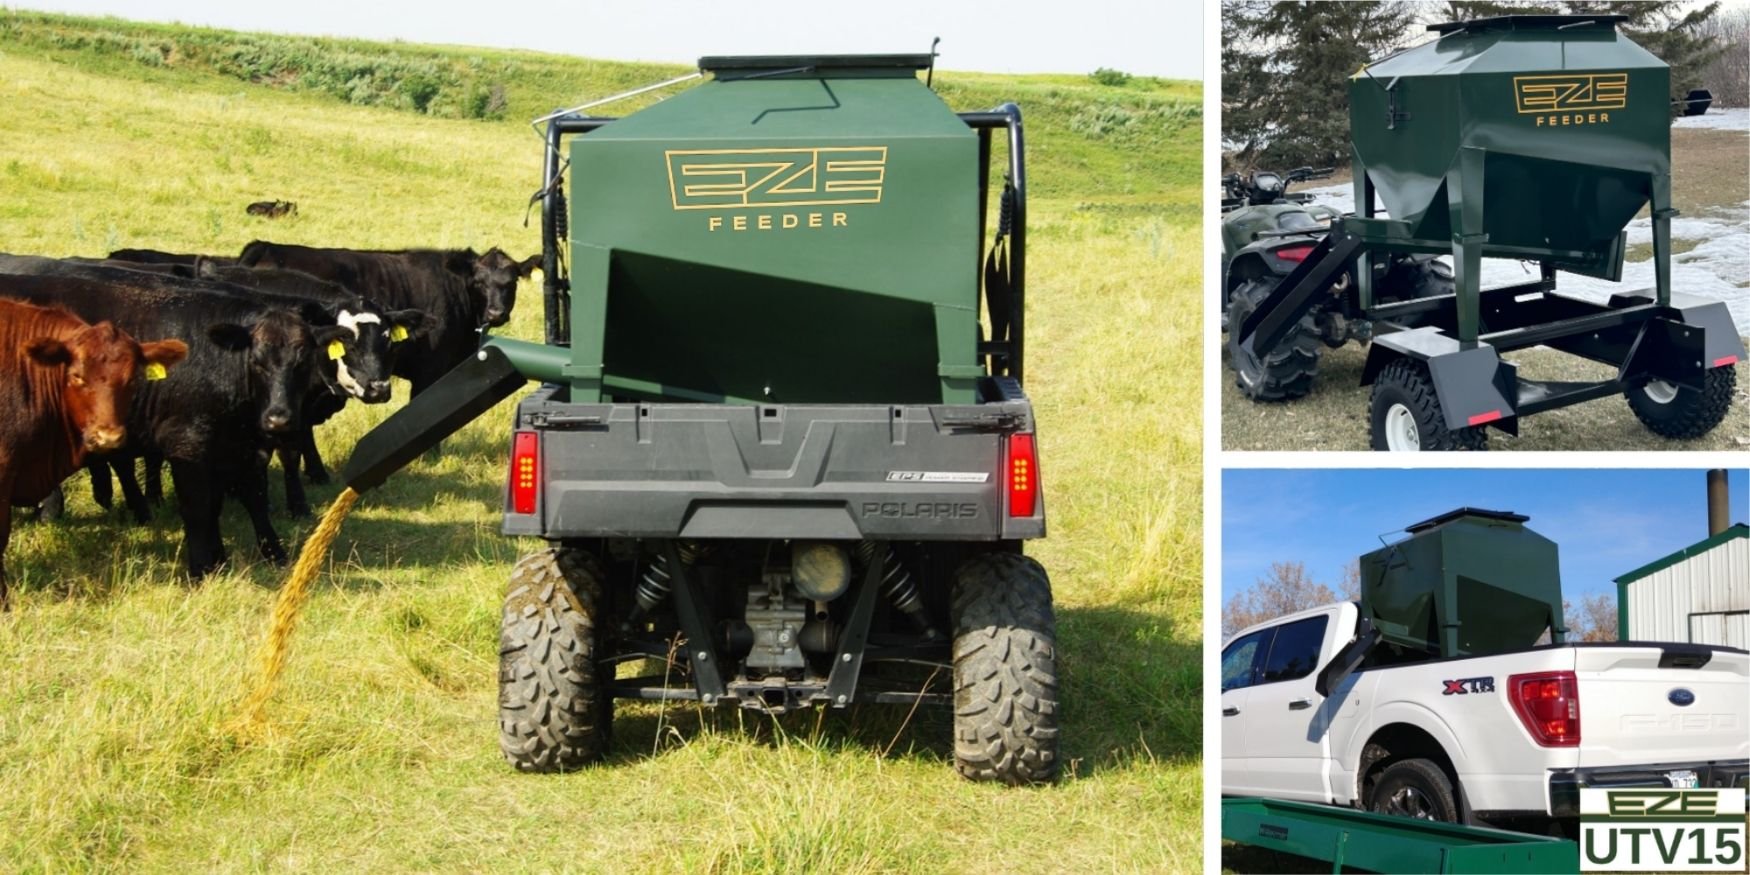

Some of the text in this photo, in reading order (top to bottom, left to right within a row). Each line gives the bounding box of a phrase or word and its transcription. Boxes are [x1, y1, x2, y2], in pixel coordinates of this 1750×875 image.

[1513, 73, 1628, 113] EZE
[1536, 113, 1609, 127] FEEDER
[665, 146, 888, 210] EZE
[709, 212, 848, 232] FEEDER
[862, 502, 979, 518] POLARIS
[1442, 676, 1495, 695] XTR
